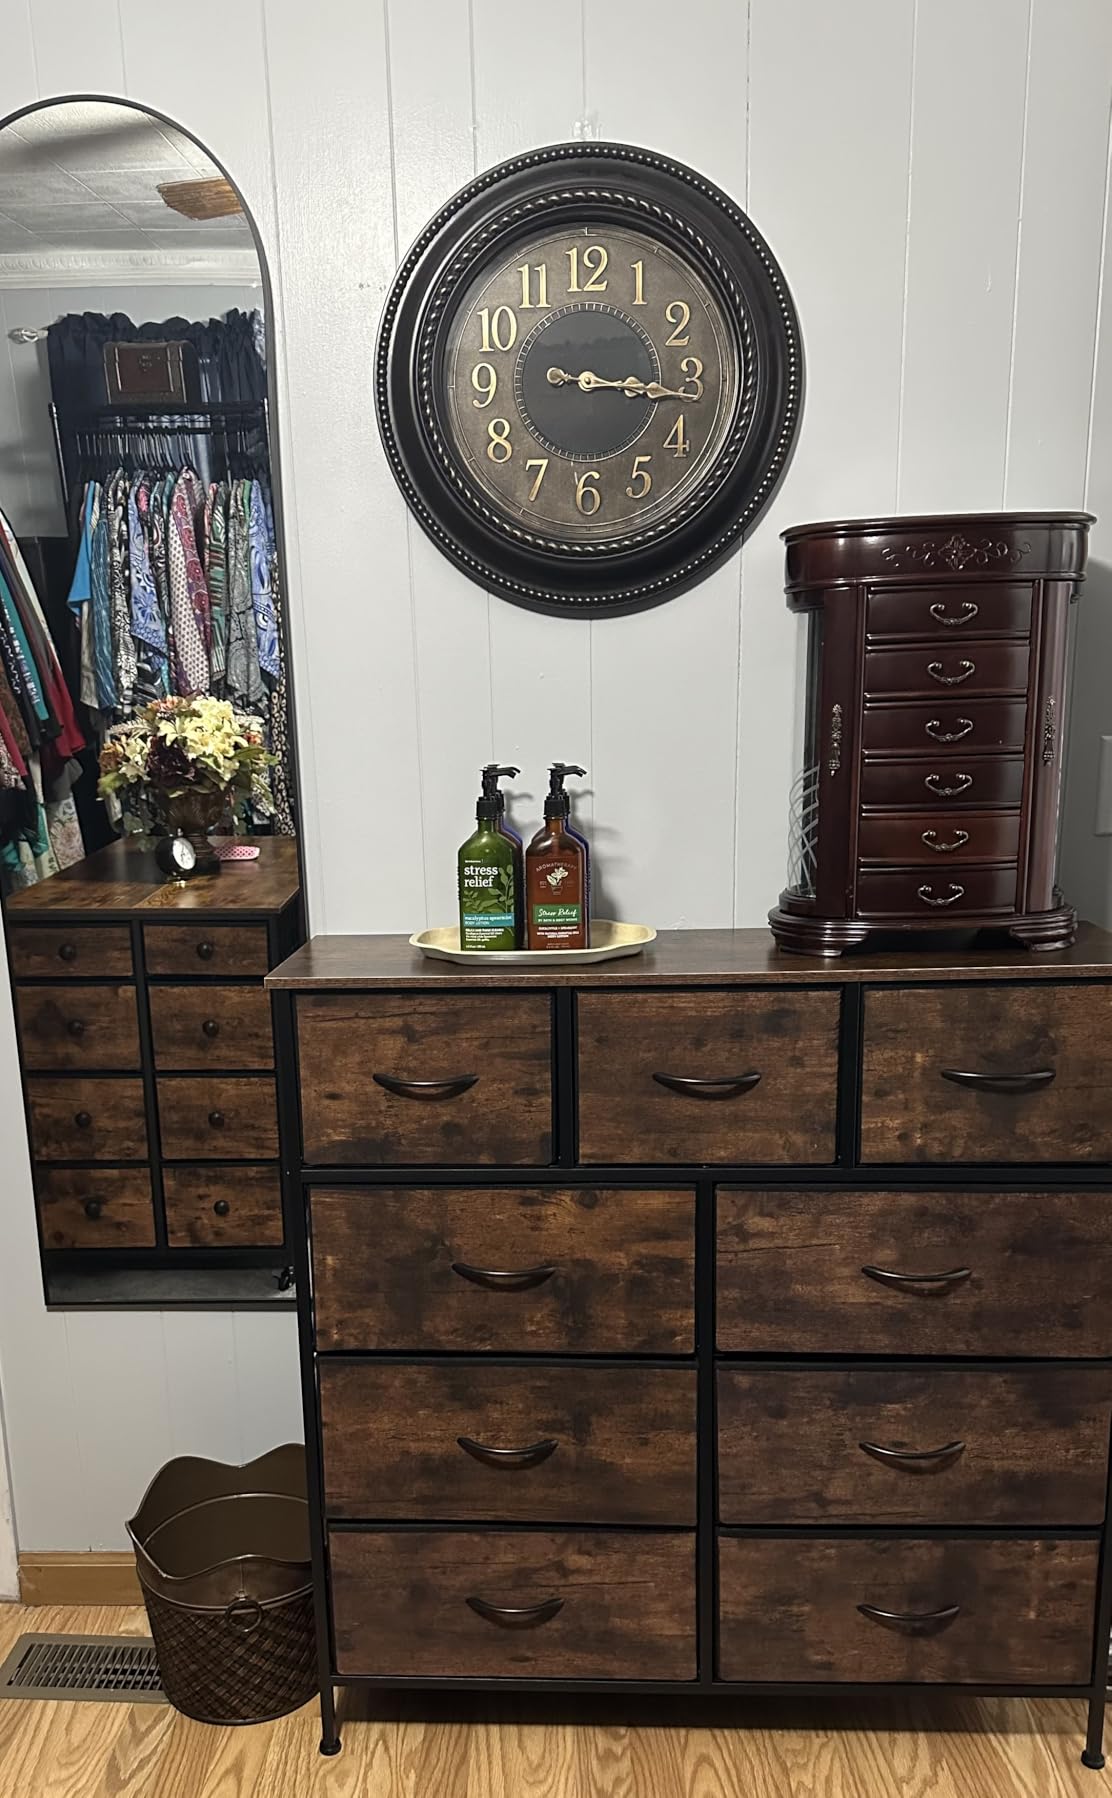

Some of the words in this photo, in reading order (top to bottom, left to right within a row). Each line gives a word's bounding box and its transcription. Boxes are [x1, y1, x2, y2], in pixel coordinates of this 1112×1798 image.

[517, 264, 551, 309] 11
[565, 246, 608, 292] 12
[630, 260, 647, 305] 1
[477, 305, 518, 352] 10
[665, 301, 691, 347] 2
[471, 362, 497, 409] 9
[679, 357, 704, 402] 3
[487, 418, 512, 463] 8
[663, 414, 690, 458] 4
[525, 459, 549, 501] 7
[575, 471, 601, 516] 6
[625, 456, 652, 499] 5
[464, 865, 498, 875] stress
[464, 876, 494, 887] relief
[558, 908, 577, 917] Relief
